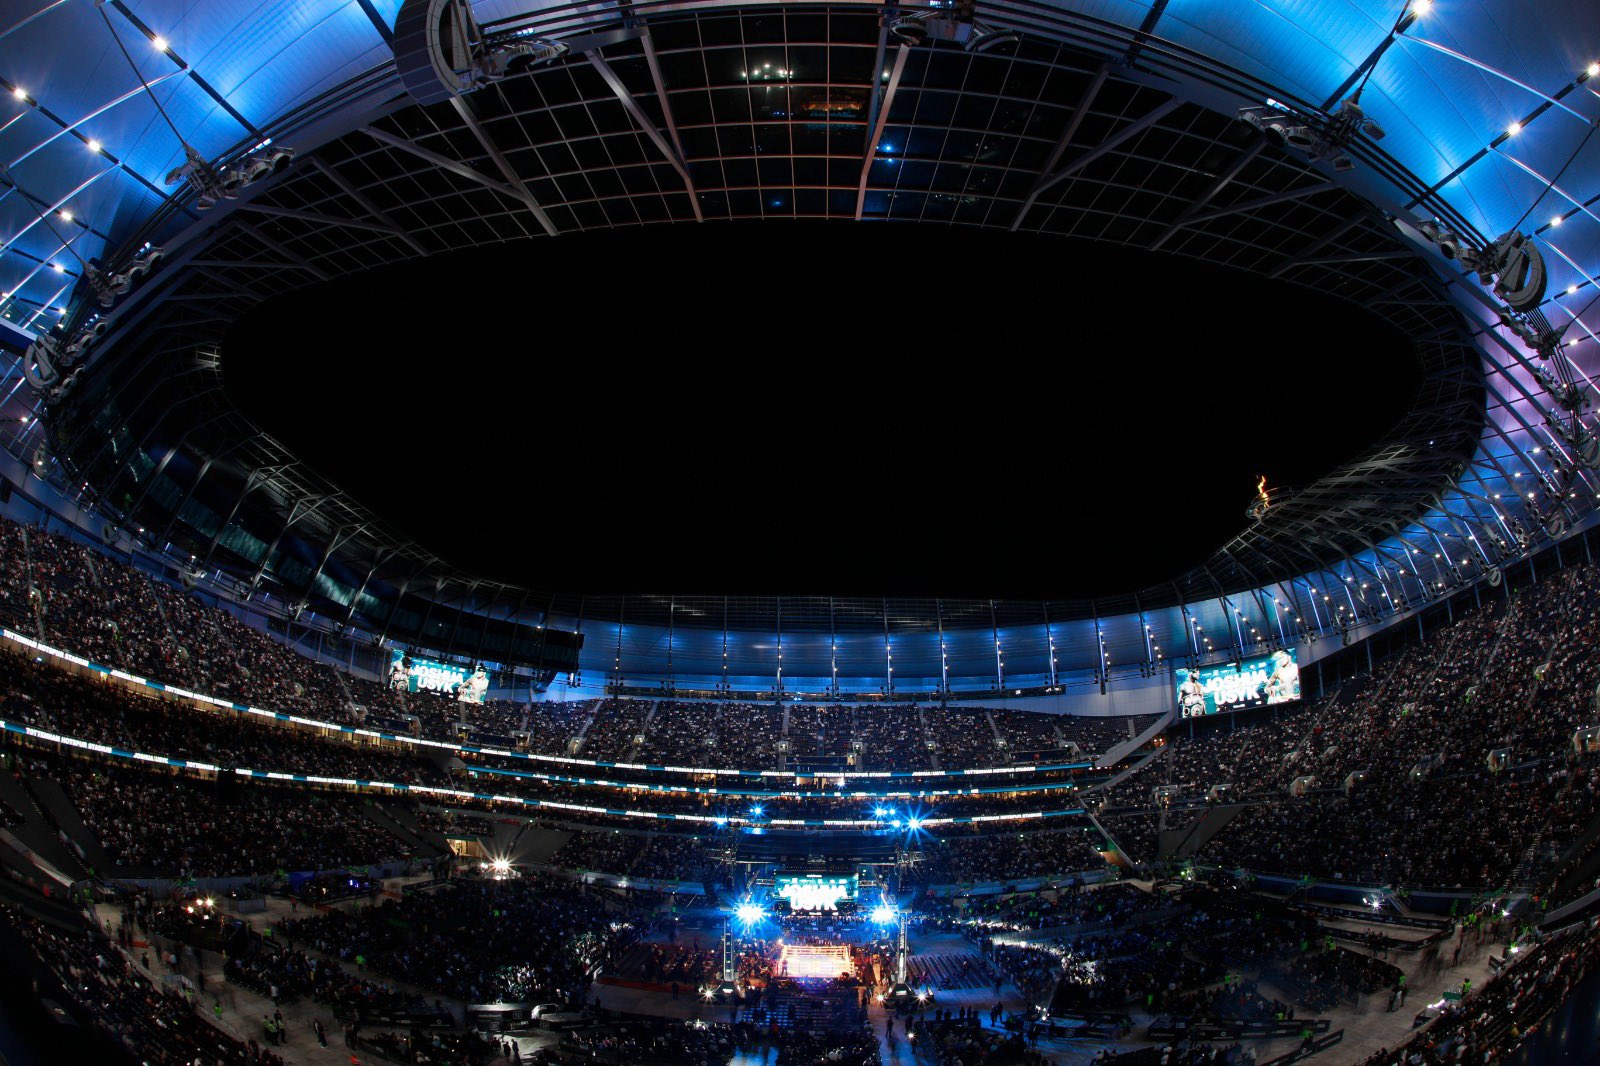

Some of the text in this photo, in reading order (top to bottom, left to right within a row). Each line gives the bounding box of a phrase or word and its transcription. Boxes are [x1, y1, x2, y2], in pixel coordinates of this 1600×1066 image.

[409, 665, 463, 684] JOSHUA
[1203, 670, 1268, 693] JOSHUA
[417, 676, 453, 693] USYK
[1214, 685, 1260, 705] USYK
[791, 896, 837, 910] USYK
